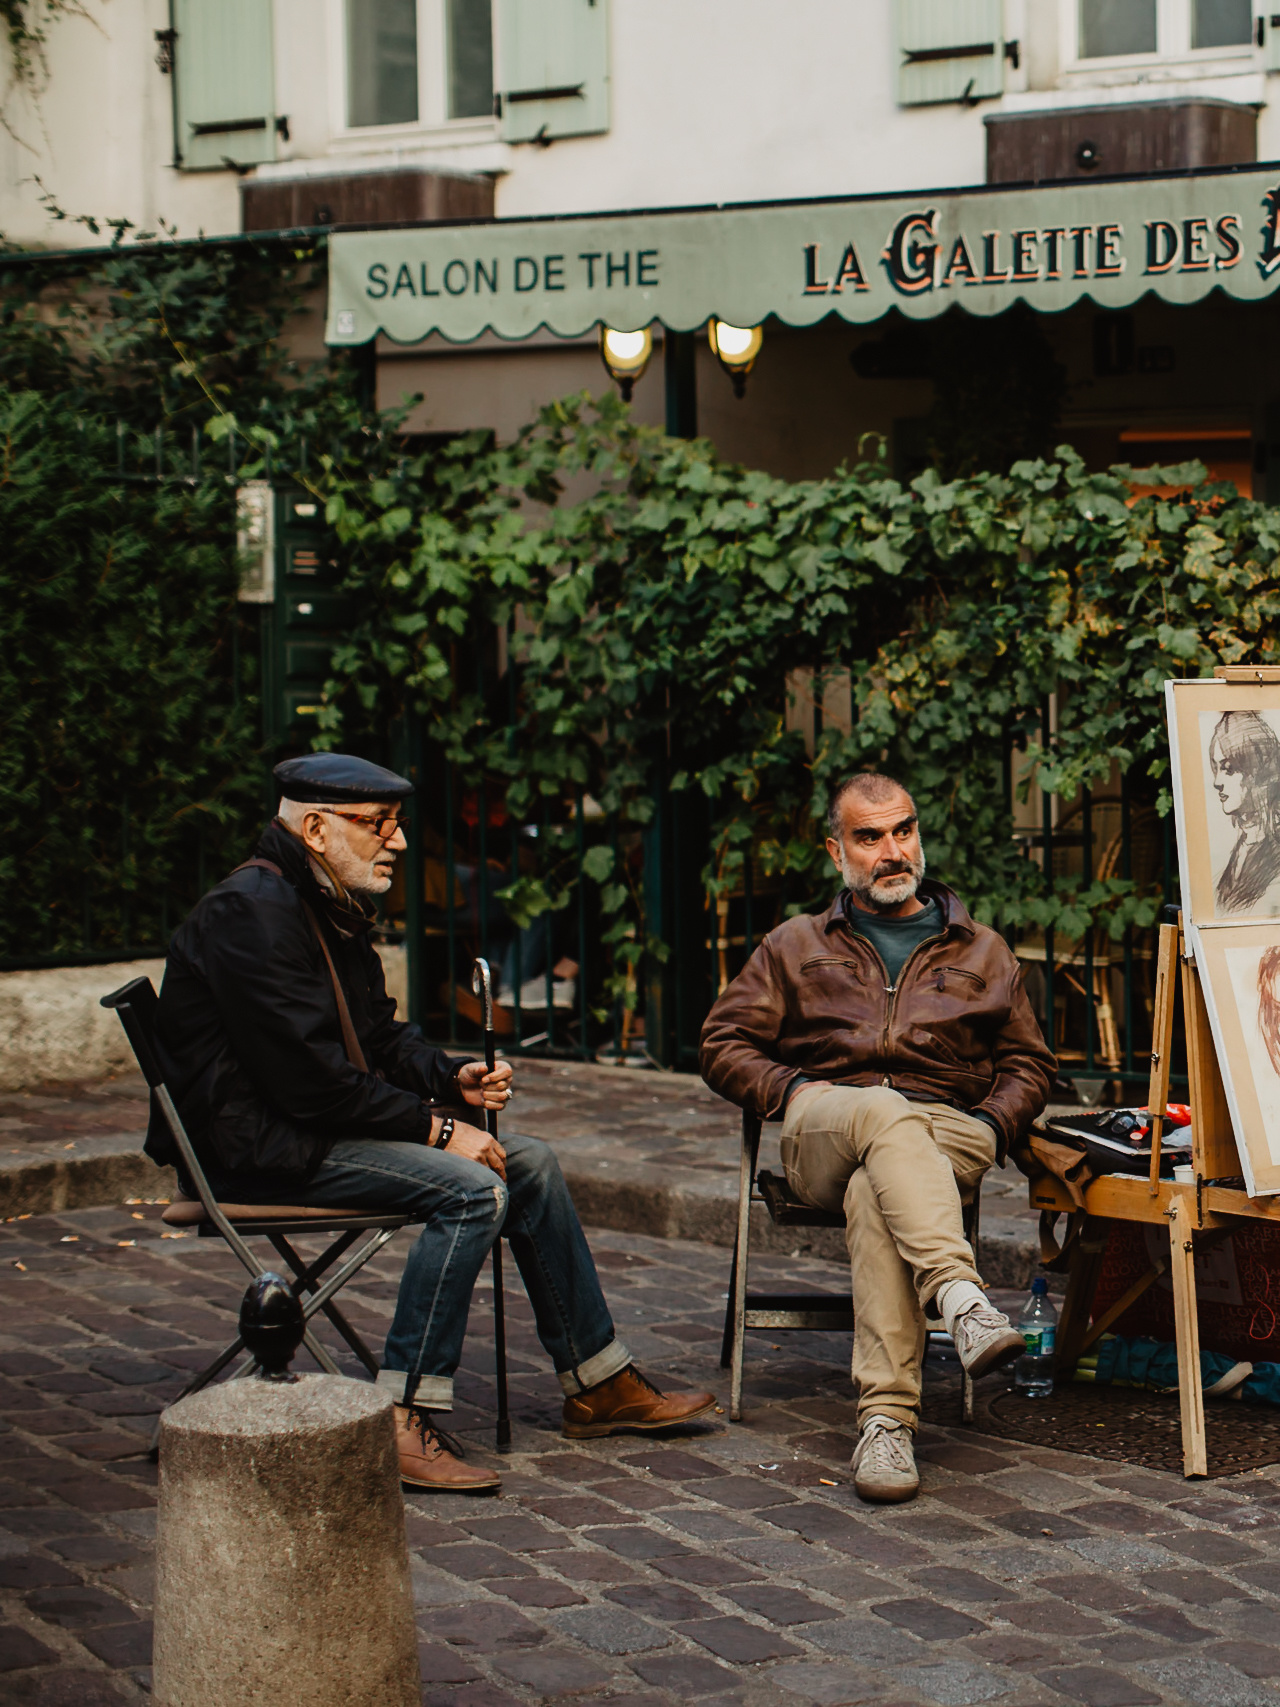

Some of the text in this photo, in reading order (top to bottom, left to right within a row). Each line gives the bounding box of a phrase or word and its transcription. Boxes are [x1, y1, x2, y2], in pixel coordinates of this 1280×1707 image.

[366, 248, 660, 301] SALON DE THE
[802, 240, 870, 296] LA
[880, 206, 1126, 298] GALETTE
[1143, 214, 1243, 275] DES
